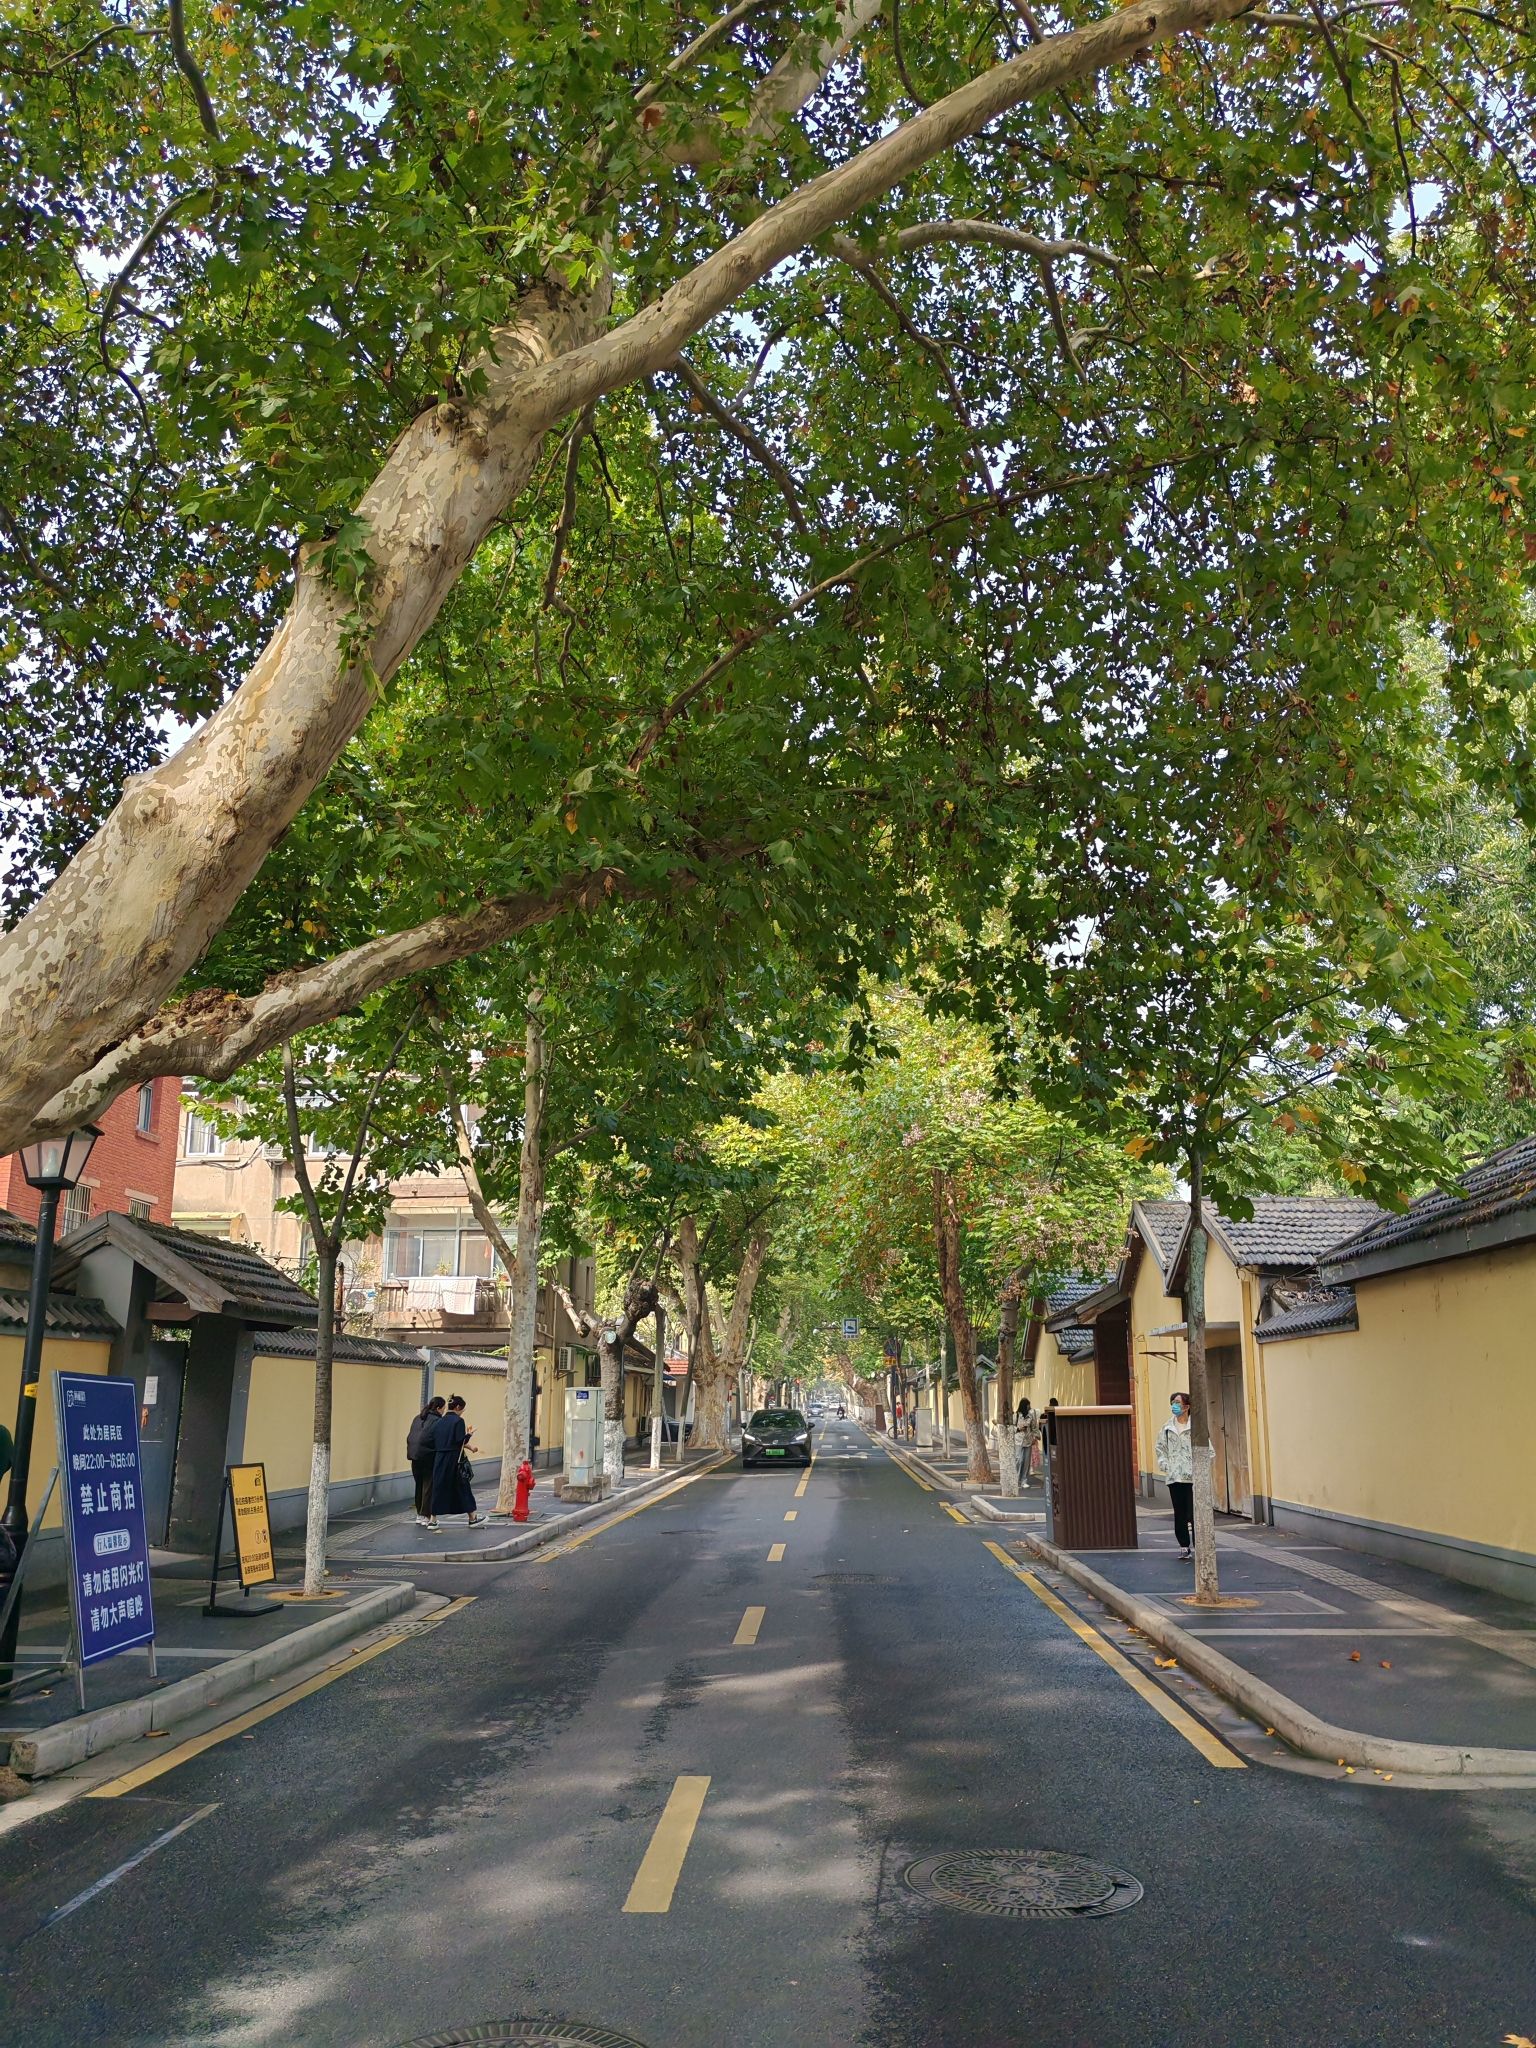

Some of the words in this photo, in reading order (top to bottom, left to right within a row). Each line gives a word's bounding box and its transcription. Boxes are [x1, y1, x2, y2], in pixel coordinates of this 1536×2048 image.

[83, 1424, 122, 1440] 此处为居民区
[81, 1481, 135, 1515] 禁止商拍
[83, 1561, 144, 1597] 请勿使用闪光灯
[91, 1595, 143, 1632] 请勿大声喧哗
